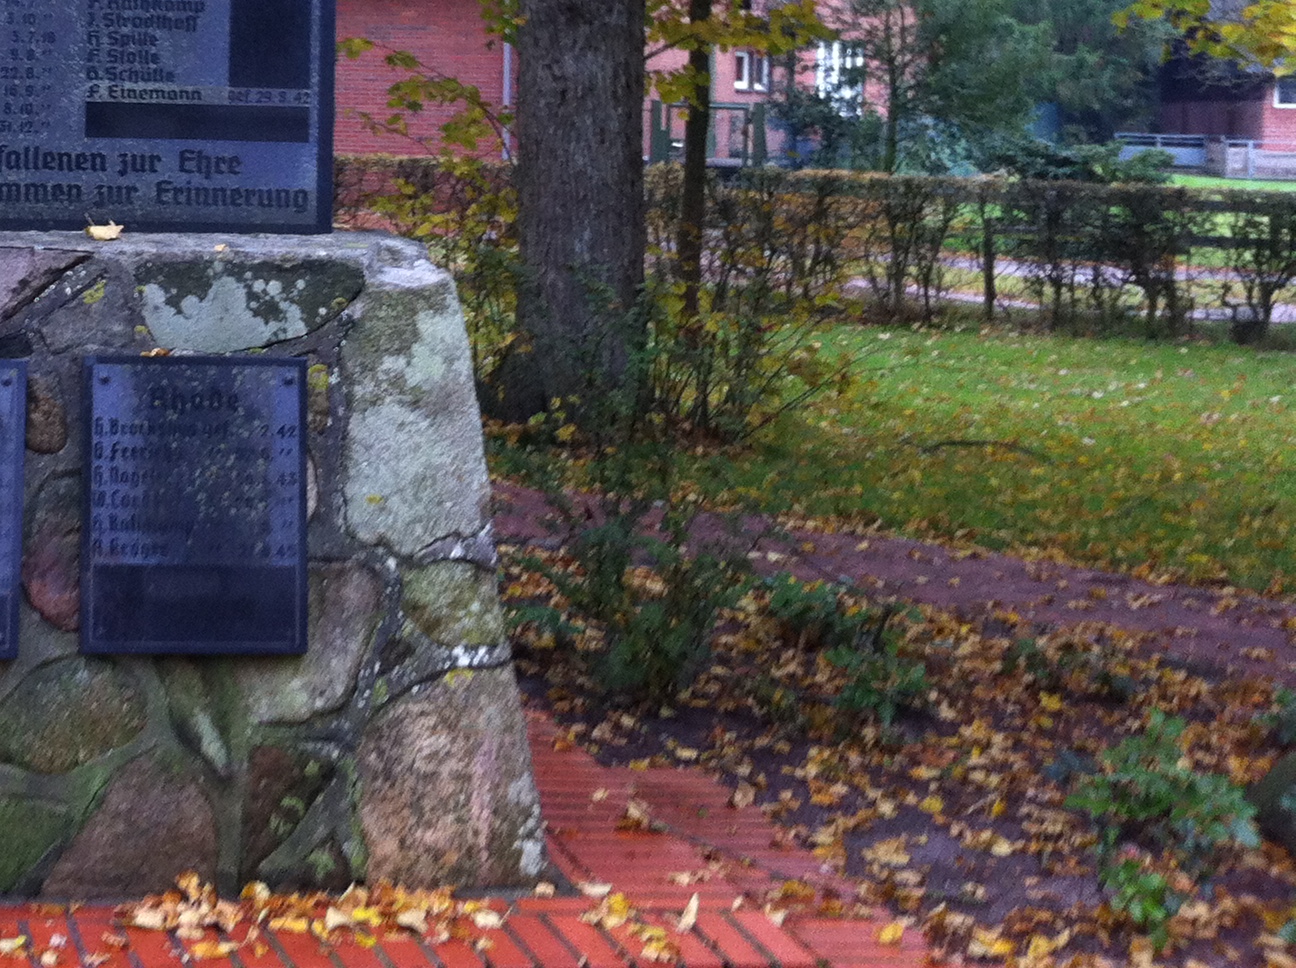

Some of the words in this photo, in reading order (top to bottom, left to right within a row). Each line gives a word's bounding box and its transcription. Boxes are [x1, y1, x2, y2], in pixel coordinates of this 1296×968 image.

[107, 83, 203, 102] Einemann
[117, 151, 163, 177] zur
[178, 148, 243, 180] Ehre
[95, 181, 140, 209] zur
[155, 179, 310, 215] Erinnerung
